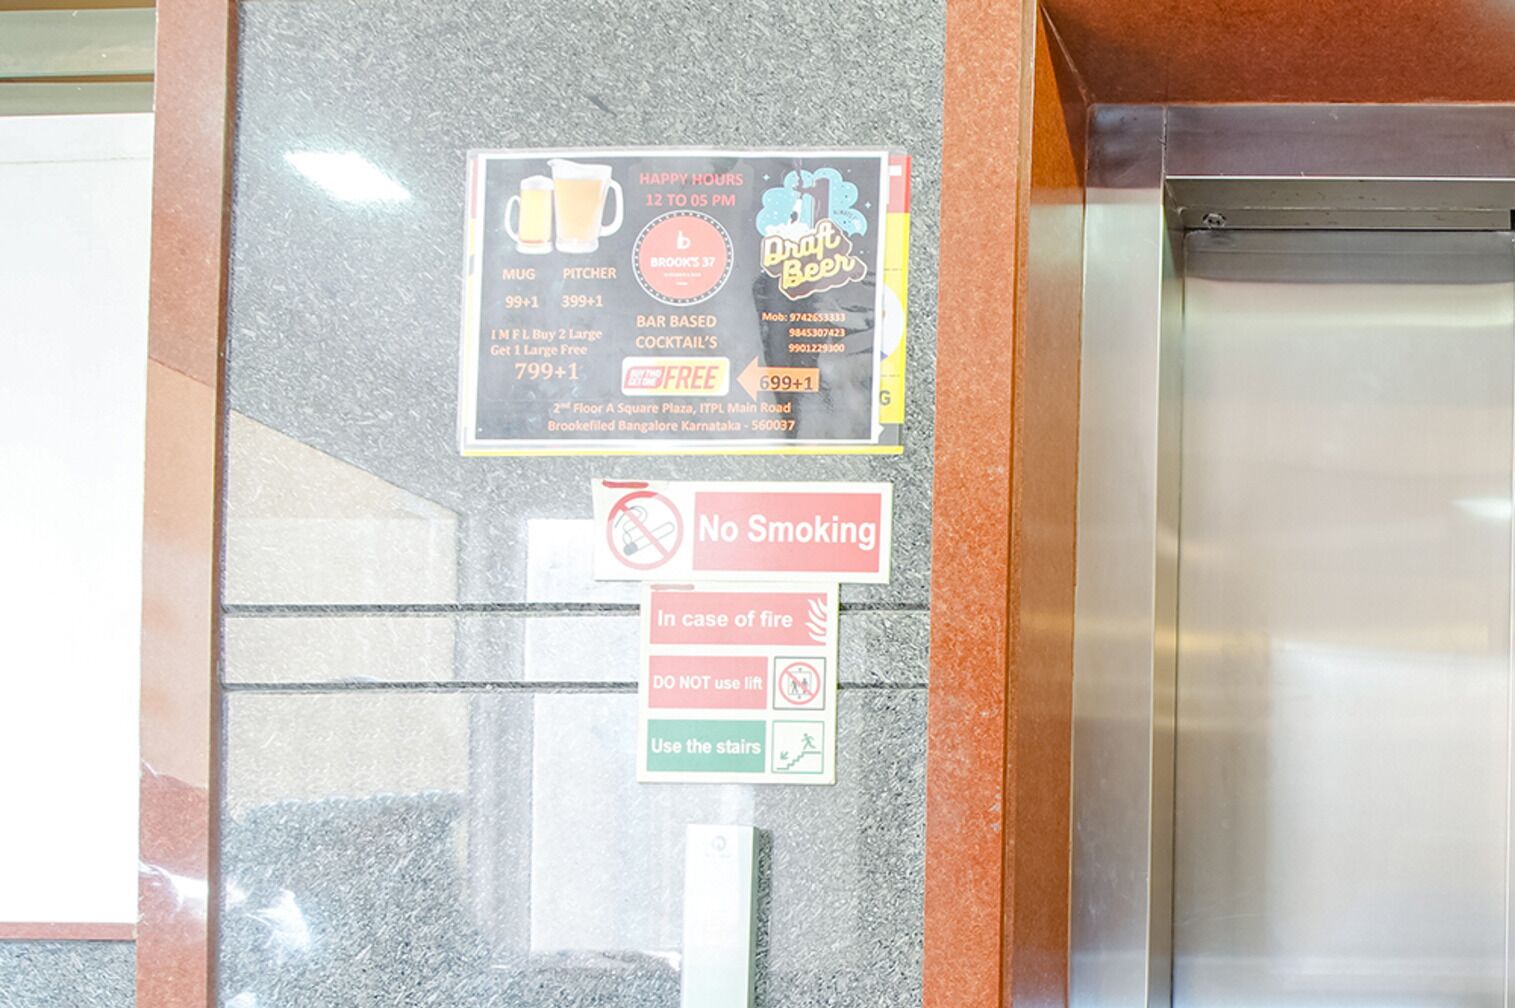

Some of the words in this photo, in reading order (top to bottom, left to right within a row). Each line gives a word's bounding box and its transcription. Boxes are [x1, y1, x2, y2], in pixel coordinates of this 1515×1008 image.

[640, 172, 688, 185] HAPPY
[692, 172, 744, 186] HOURS
[646, 193, 663, 206] 12
[667, 193, 687, 207] TO
[690, 193, 708, 207] 05
[712, 194, 737, 207] PM
[763, 221, 842, 268] Draft
[702, 256, 716, 268] 37
[502, 267, 536, 281] MUG
[562, 267, 617, 280] PITCHER
[782, 253, 856, 290] Beer
[505, 295, 540, 309] 99+1
[560, 295, 604, 308] 399+1
[635, 314, 666, 328] BAR
[669, 314, 717, 329] BASED
[532, 329, 556, 343] Buy
[558, 329, 567, 340] 2
[569, 329, 603, 343] Large
[490, 345, 511, 356] Get
[514, 345, 520, 356] 1
[523, 345, 558, 359] Large
[560, 345, 588, 356] Free
[514, 362, 580, 380] 799+1
[663, 365, 720, 389] FREE
[759, 375, 814, 391] 699+1
[573, 402, 603, 414] Floor
[605, 402, 615, 413] A
[617, 402, 660, 416] Square
[699, 402, 724, 413] ITPL
[727, 402, 757, 413] Main
[760, 402, 792, 413] Road
[618, 420, 679, 433] Bangalore
[681, 420, 741, 432] Karnataka
[751, 420, 796, 431] 560037
[698, 515, 739, 543] No
[747, 514, 877, 550] Smoking
[657, 610, 676, 628] In
[682, 613, 729, 628] case
[735, 610, 756, 628] of
[760, 610, 793, 628] fire
[653, 675, 677, 690] DO
[679, 675, 712, 690] NOT
[715, 679, 741, 691] use
[744, 676, 764, 691] lift
[651, 737, 682, 753] Use
[685, 738, 712, 753] the
[715, 739, 762, 754] stairs
